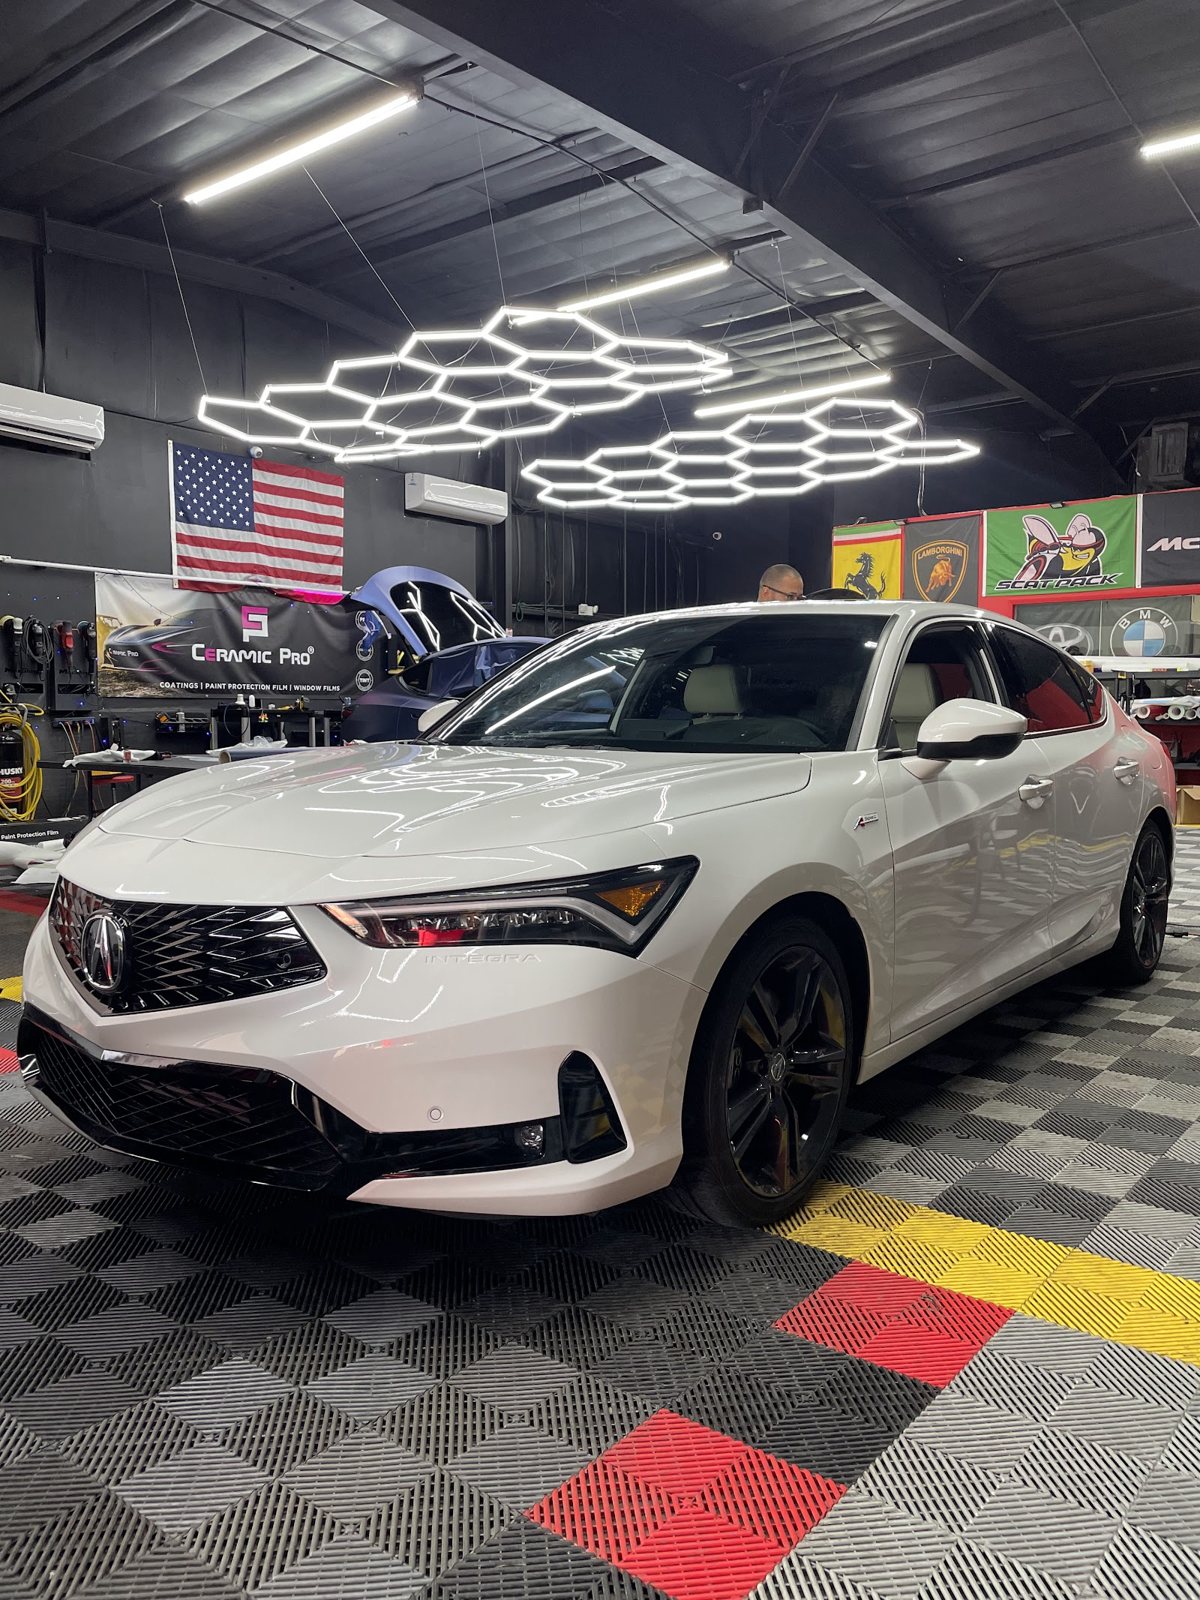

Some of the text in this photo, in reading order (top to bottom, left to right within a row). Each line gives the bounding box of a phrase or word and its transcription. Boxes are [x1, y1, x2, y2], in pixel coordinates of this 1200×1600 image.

[918, 546, 963, 560] LAMBORGHINI
[995, 573, 1121, 590] SCAT PACK
[159, 681, 199, 690] COATINGS
[227, 683, 270, 691] PROTECTION
[16, 830, 46, 839] Protection
[425, 953, 541, 963] INTEGRA
